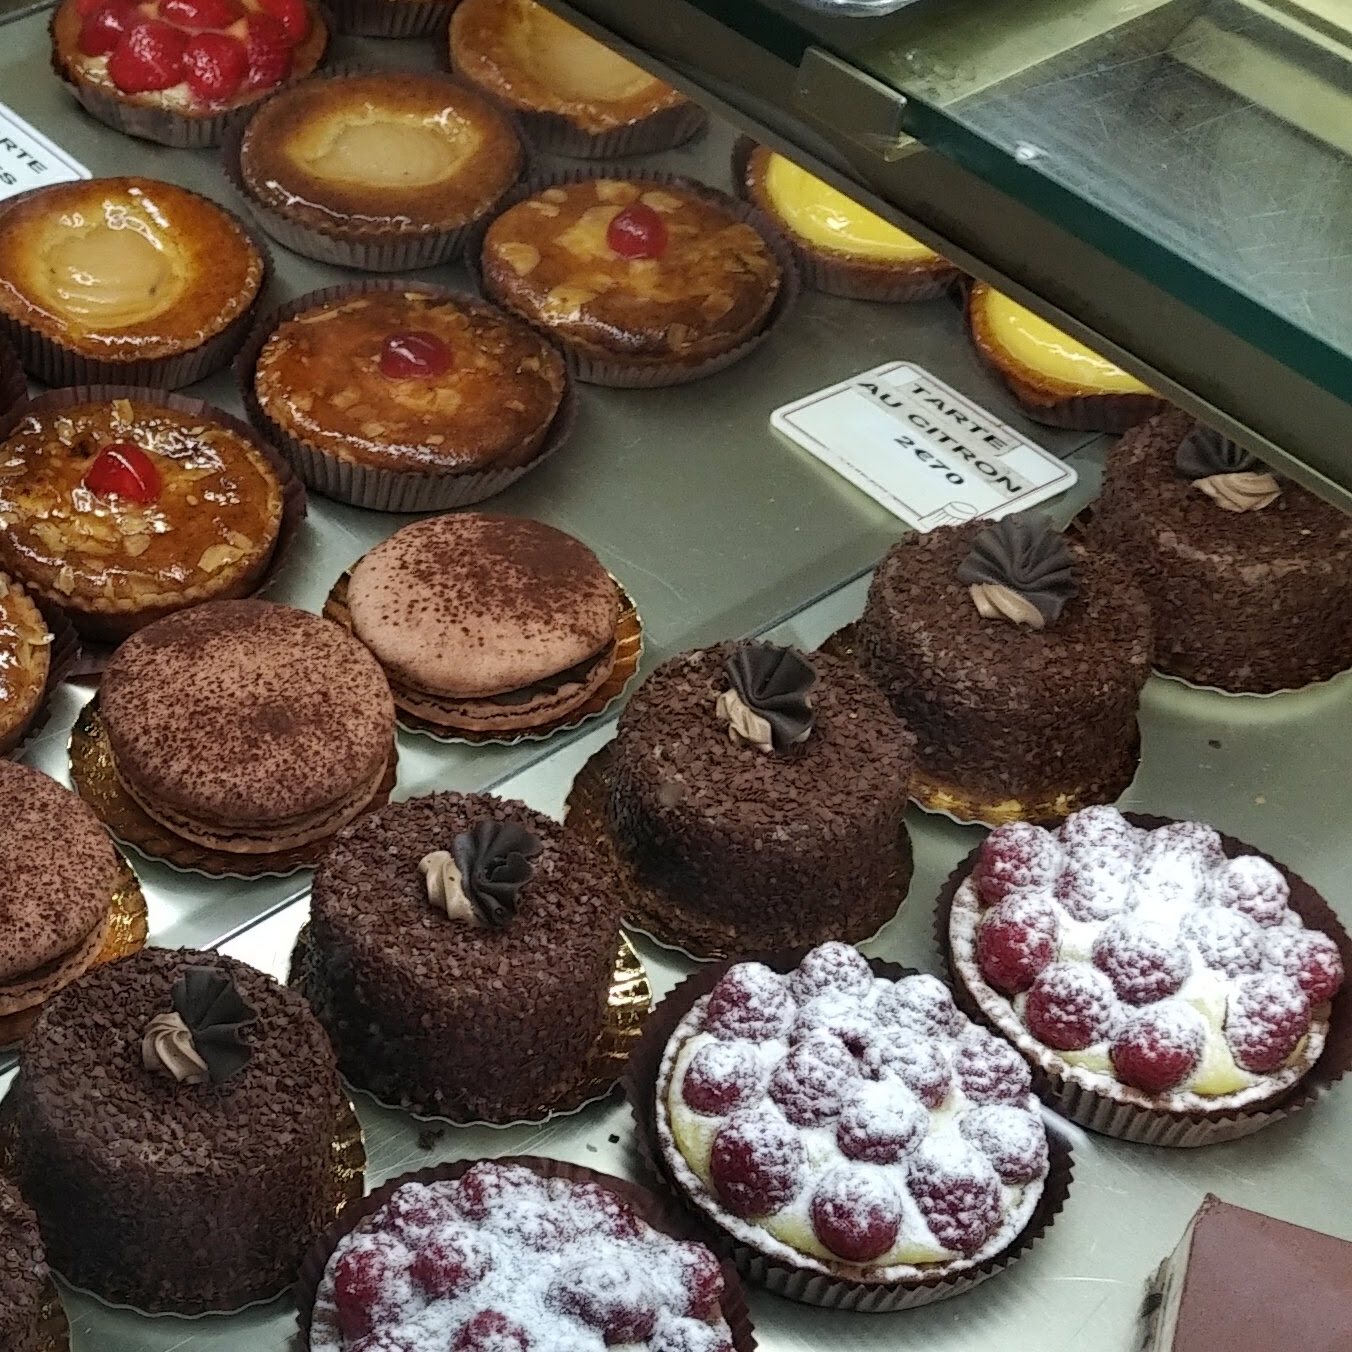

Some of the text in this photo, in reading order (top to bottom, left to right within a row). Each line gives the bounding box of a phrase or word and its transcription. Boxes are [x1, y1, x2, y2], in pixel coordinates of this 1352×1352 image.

[856, 382, 1022, 494] AU CITRON
[911, 382, 1009, 451] TARTE
[893, 435, 965, 486] 2€70
